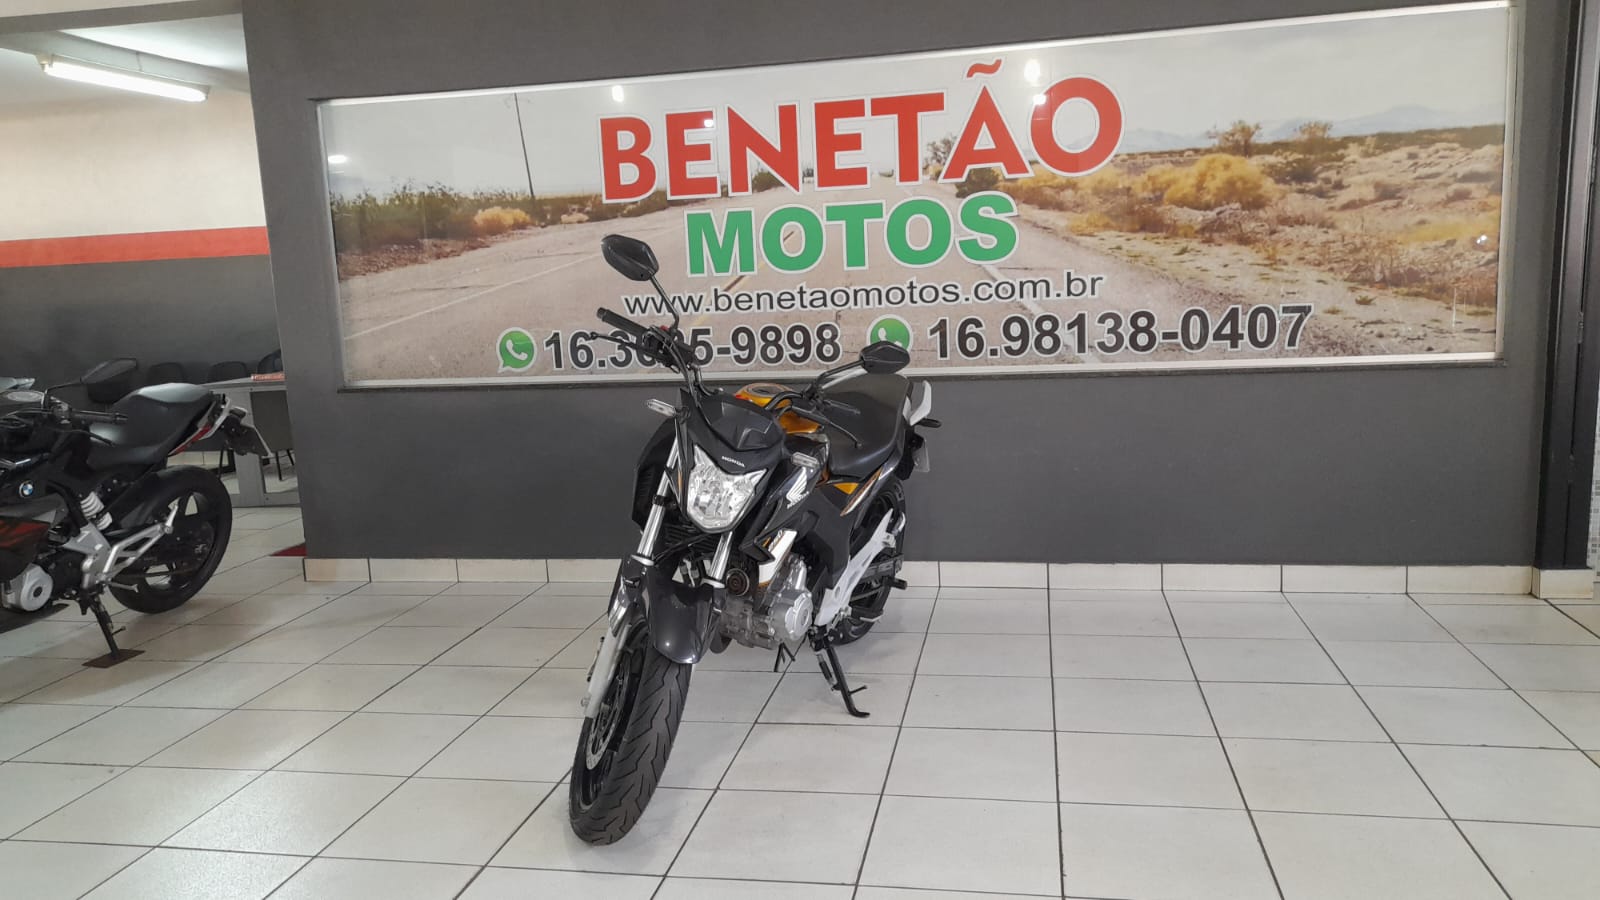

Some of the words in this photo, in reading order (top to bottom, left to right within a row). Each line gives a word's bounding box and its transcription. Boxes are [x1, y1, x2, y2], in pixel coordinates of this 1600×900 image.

[599, 59, 1122, 200] BENETÃO
[687, 194, 1017, 274] MOTOS
[624, 273, 1103, 315] www.benetaomotos.com.br
[545, 324, 840, 368] 16.35-9898
[928, 304, 1313, 358] 16.98138-0407
